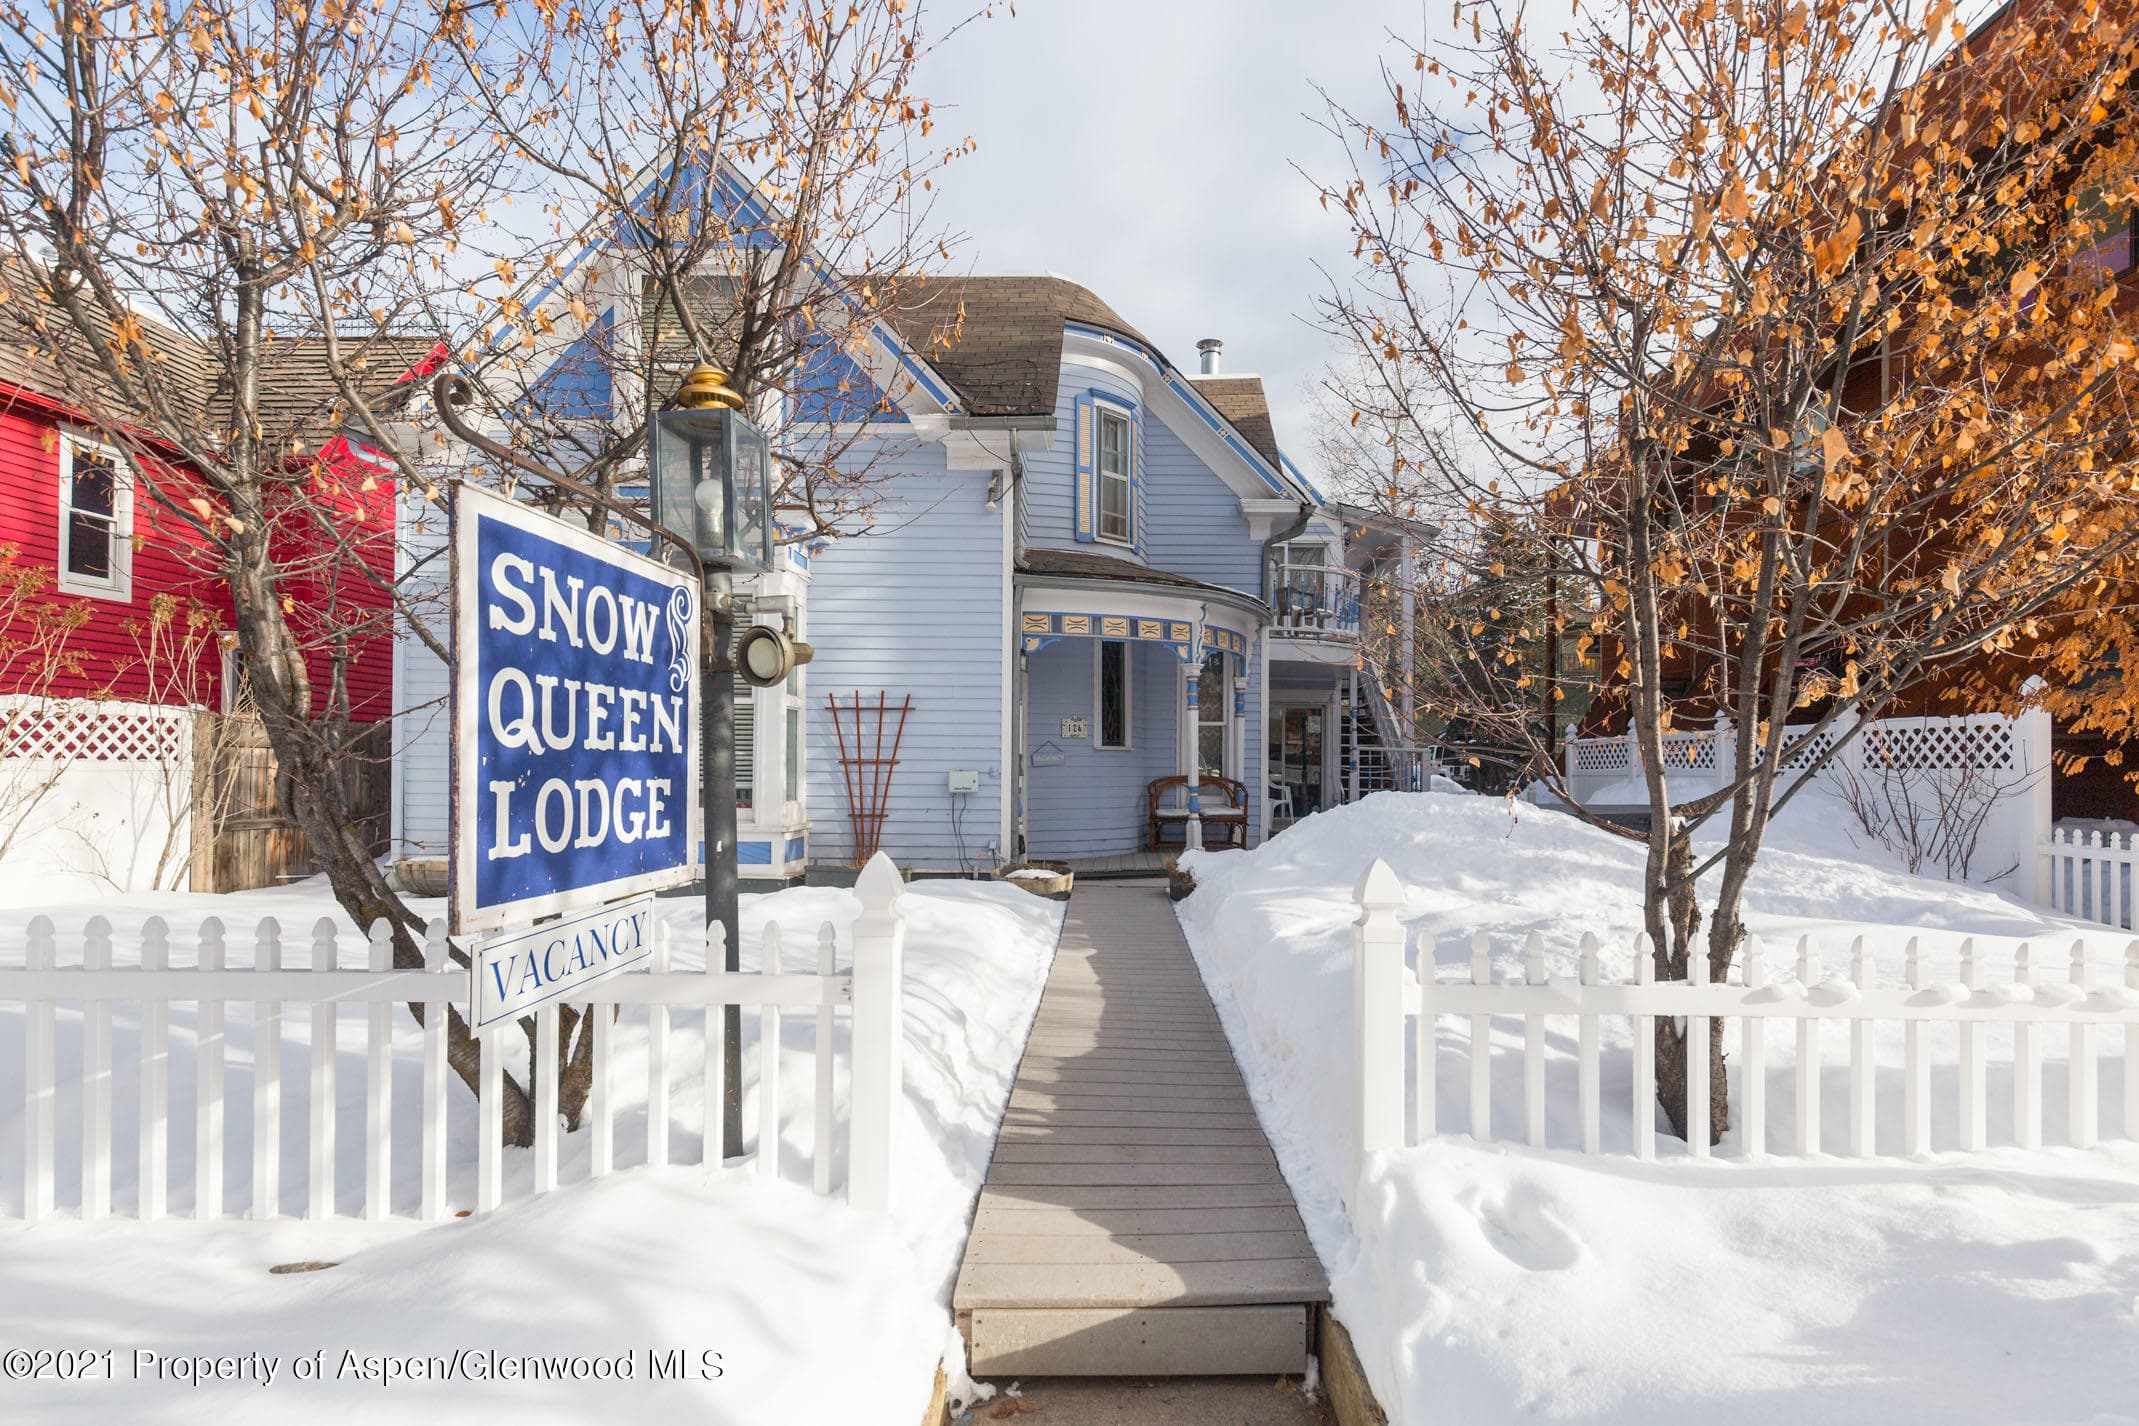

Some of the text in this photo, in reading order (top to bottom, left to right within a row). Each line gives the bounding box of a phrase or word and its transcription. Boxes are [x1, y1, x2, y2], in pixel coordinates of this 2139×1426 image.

[489, 552, 660, 664] SNOW
[488, 667, 683, 756] QUEEN
[488, 777, 671, 861] LODGE
[490, 911, 647, 1003] VACANCY
